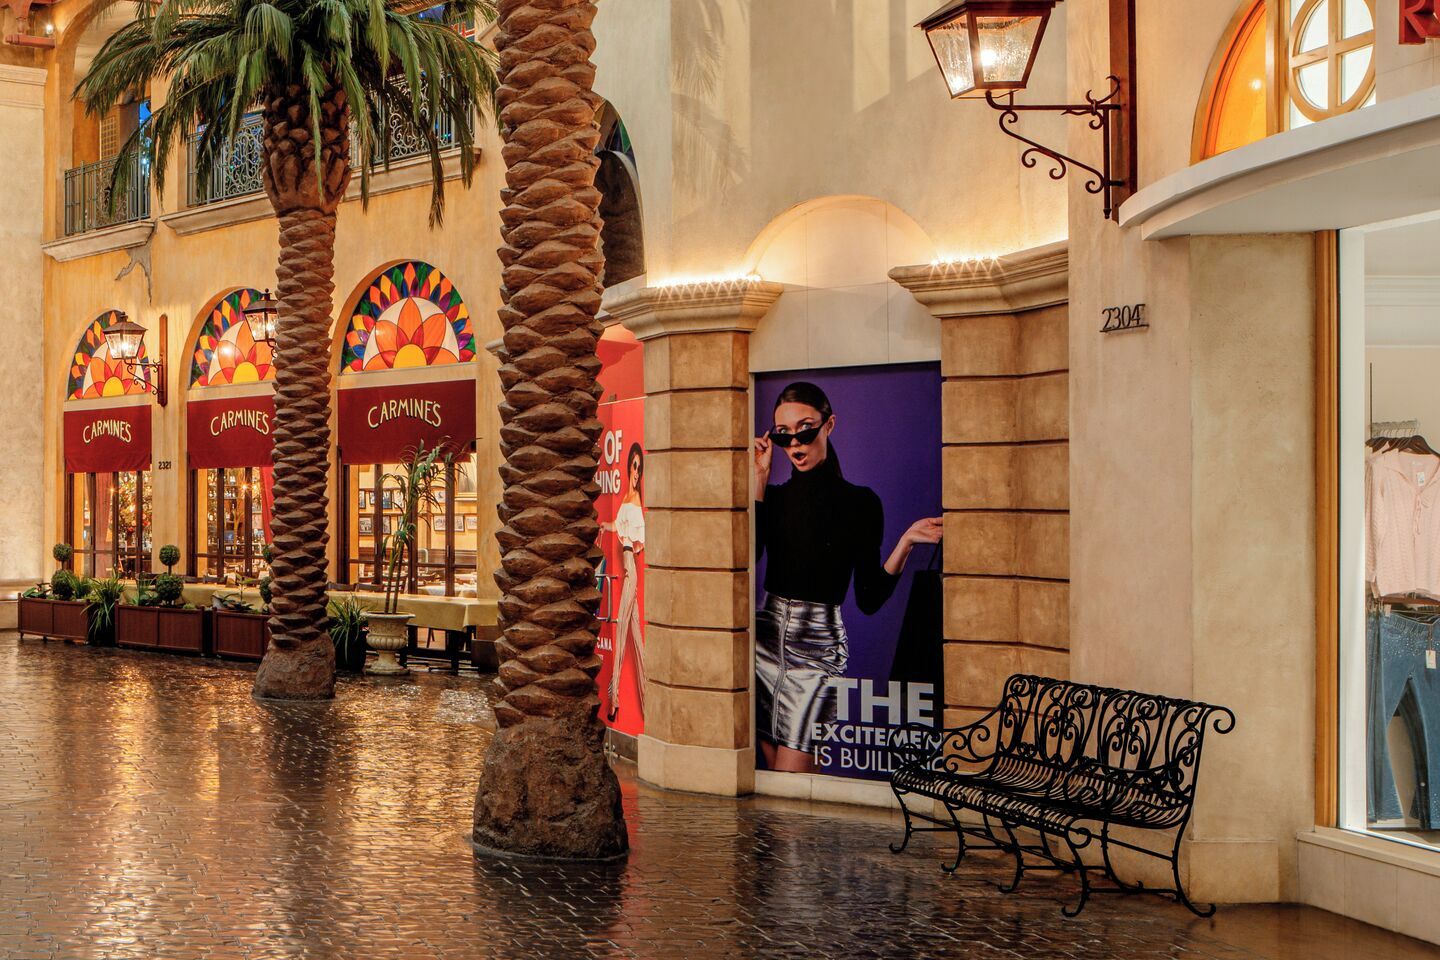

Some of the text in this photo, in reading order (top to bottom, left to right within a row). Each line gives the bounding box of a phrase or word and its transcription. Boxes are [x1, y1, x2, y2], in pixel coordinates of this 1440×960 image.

[1101, 304, 1146, 330] 2304
[210, 409, 270, 436] CARMINE'S
[368, 398, 441, 428] CARMINE'S
[82, 420, 132, 444] CARMINE'S
[604, 429, 623, 465] OF
[158, 461, 171, 470] 2321
[828, 677, 934, 727] THE
[814, 745, 832, 767] IS
